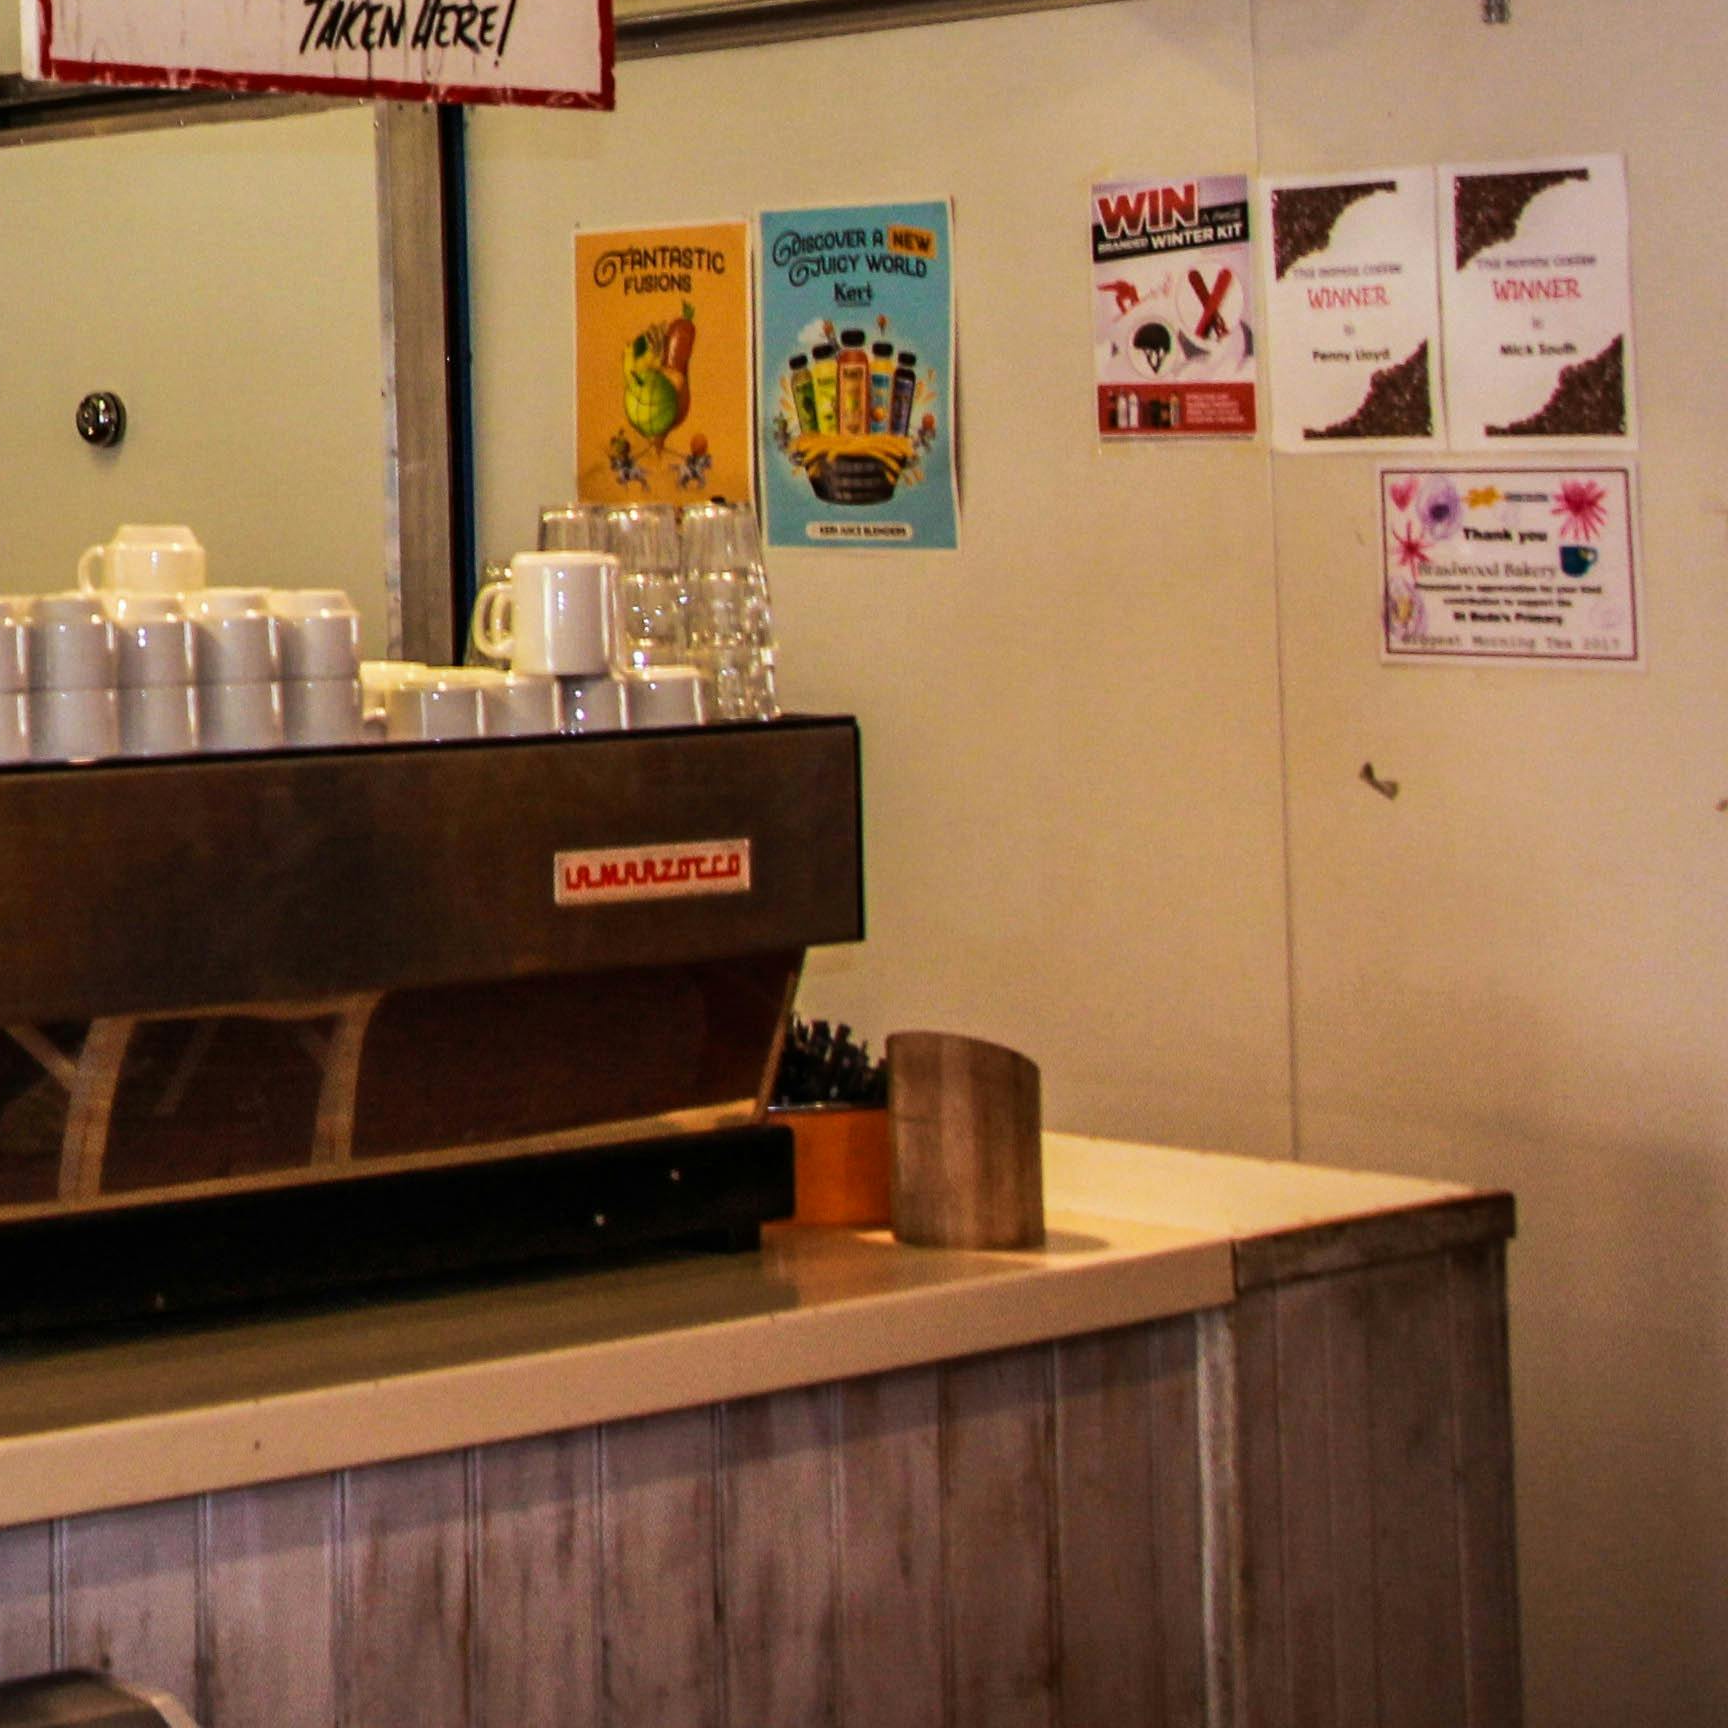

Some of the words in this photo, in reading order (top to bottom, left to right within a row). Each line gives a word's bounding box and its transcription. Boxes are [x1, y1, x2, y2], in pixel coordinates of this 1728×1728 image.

[1097, 182, 1198, 240] WIN
[773, 228, 866, 267] DISCOVER
[872, 229, 885, 248] A
[893, 231, 931, 252] NEW
[1151, 226, 1214, 250] WINTER
[1217, 223, 1243, 240] KIT
[594, 245, 725, 289] FANTASTIC
[788, 254, 860, 287] JUICY
[866, 256, 928, 279] WORLD
[623, 273, 692, 296] FUSIONS
[1307, 285, 1391, 310] WINNER
[1493, 277, 1582, 302] WINNER
